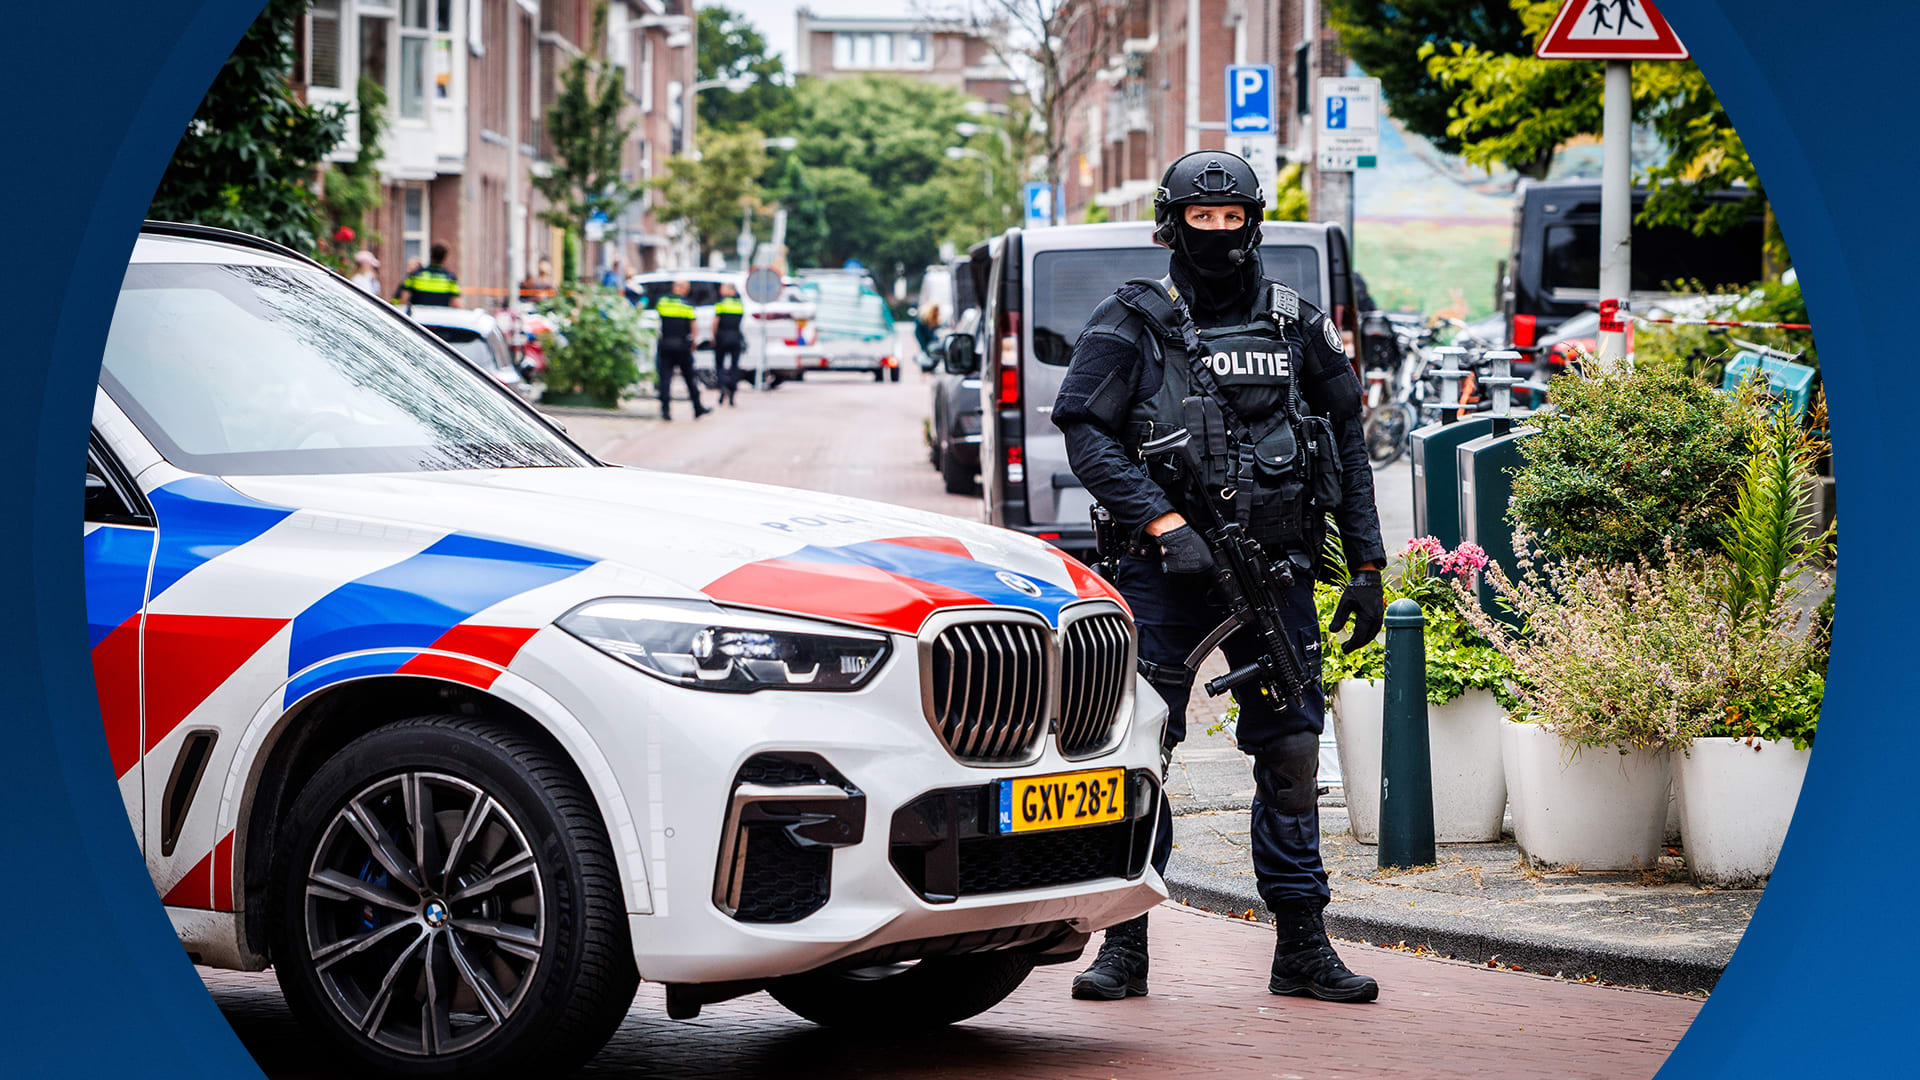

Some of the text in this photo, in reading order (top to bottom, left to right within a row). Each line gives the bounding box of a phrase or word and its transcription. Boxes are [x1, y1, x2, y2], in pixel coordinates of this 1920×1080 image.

[1236, 70, 1263, 107] P
[1330, 98, 1344, 113] P
[1022, 777, 1118, 822] GXV-28-Z
[1000, 812, 1011, 823] NL
